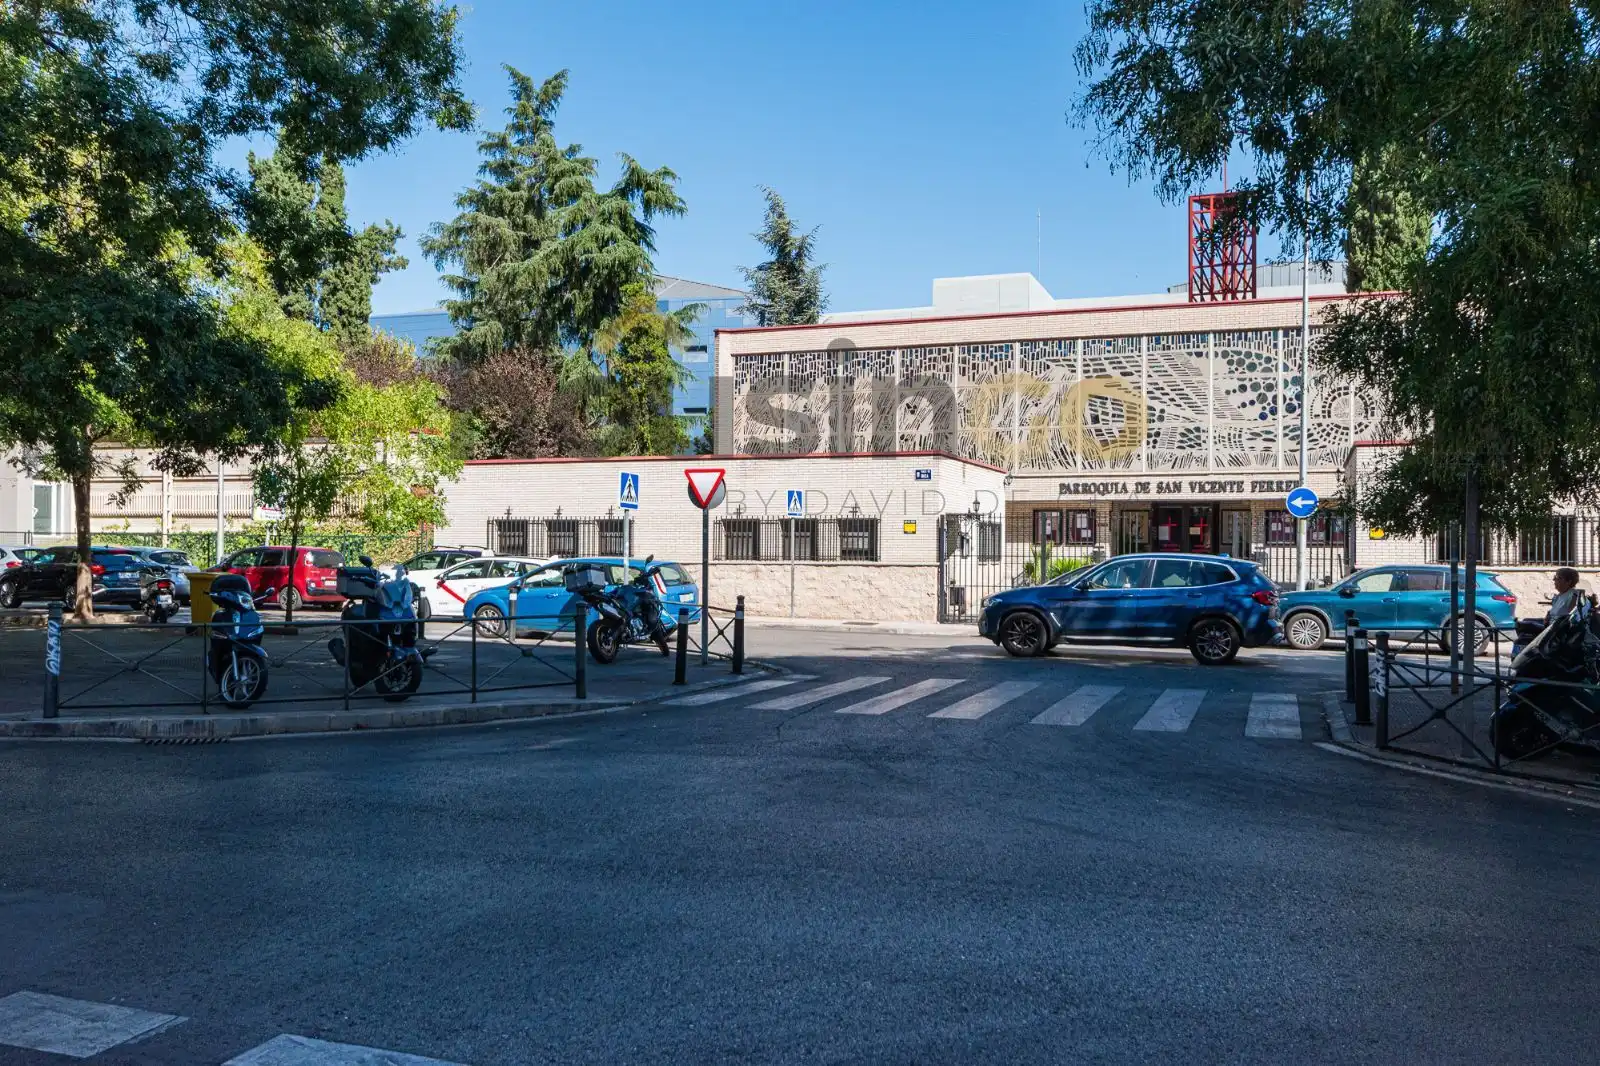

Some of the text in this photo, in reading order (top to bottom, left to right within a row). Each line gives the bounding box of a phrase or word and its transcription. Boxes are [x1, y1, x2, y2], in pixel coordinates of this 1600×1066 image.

[1059, 482, 1128, 495] PARROQUIA
[1135, 481, 1150, 494] DE
[1156, 480, 1182, 494] SAN
[1189, 480, 1244, 493] VICENTE
